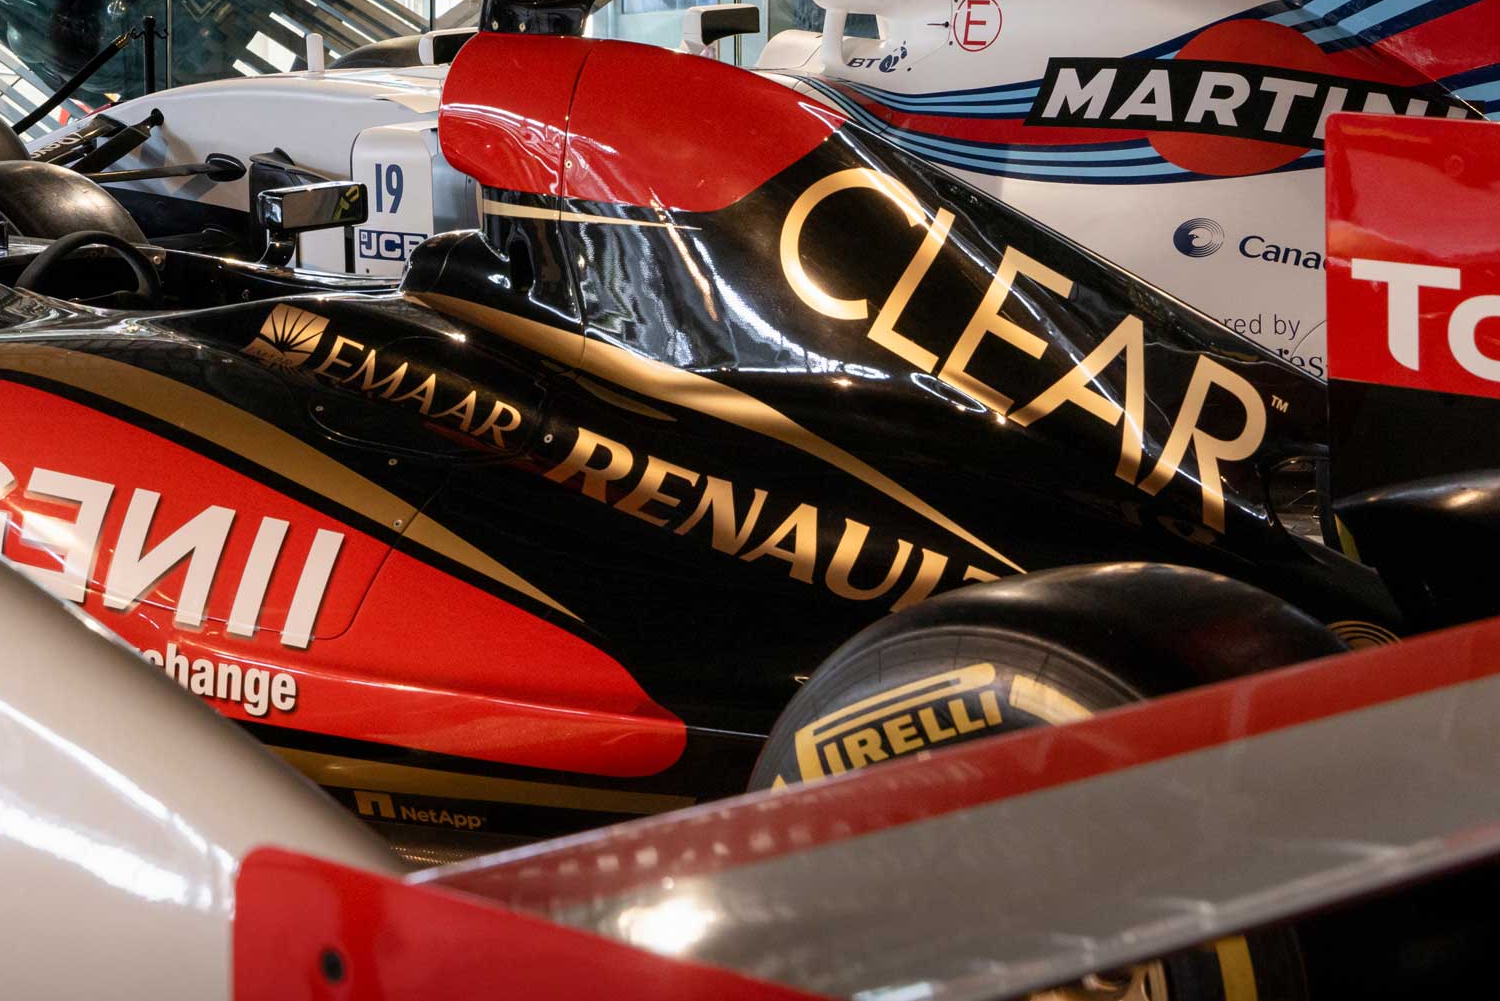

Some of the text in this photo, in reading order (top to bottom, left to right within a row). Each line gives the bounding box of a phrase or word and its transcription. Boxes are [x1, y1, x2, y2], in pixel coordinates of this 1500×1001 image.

[963, 0, 991, 46] E
[847, 57, 881, 69] BT
[1041, 67, 1469, 140] MARTI
[375, 163, 404, 214] 19
[1238, 235, 1327, 270] Cana
[780, 167, 1267, 535] CLEAR
[1273, 314, 1301, 341] by
[314, 335, 522, 448] EMAAR
[544, 427, 1002, 614] RENAUL
[795, 663, 1003, 782] PIRELLI
[402, 807, 483, 831] NetApp
